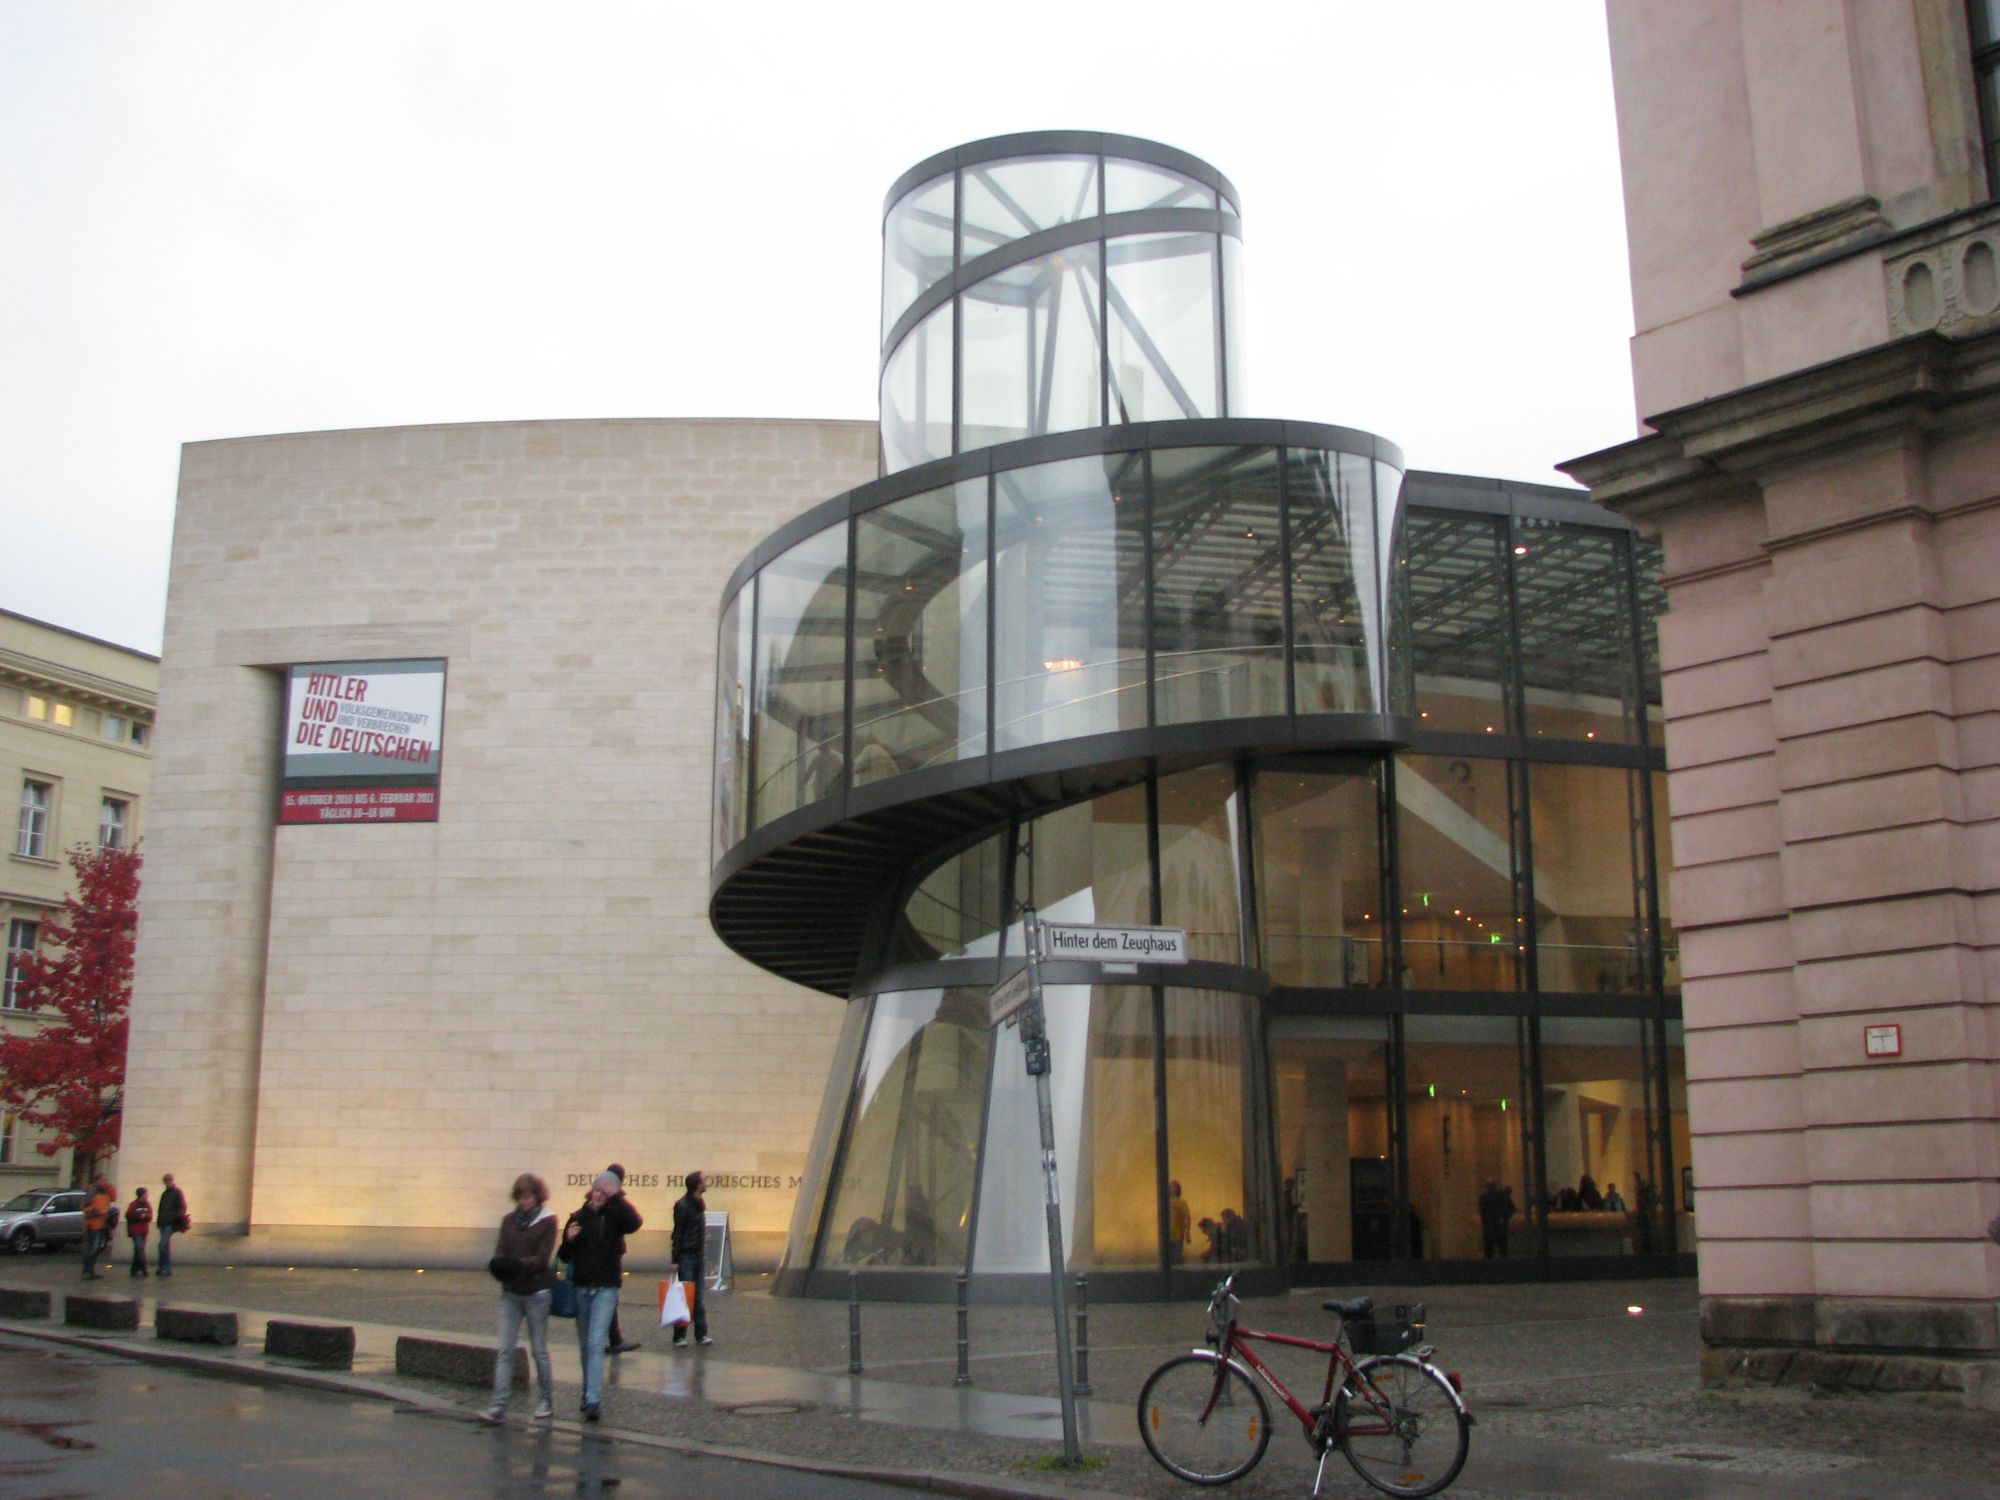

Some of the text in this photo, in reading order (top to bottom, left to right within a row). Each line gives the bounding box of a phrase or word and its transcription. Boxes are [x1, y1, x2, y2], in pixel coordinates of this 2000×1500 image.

[307, 672, 368, 702] HITLER
[302, 697, 338, 723] UND
[296, 722, 432, 764] DIE DEUTSCHEN
[298, 794, 333, 806] OKTOBER
[355, 793, 368, 804] BIS
[380, 792, 415, 804] FEBRUAR
[416, 792, 434, 803] 2011
[320, 806, 352, 819] TÄGLICH
[380, 806, 397, 818] UHR
[1052, 930, 1177, 954] Hinter dem Zeughaus
[666, 1174, 781, 1189] HIORISCHES
